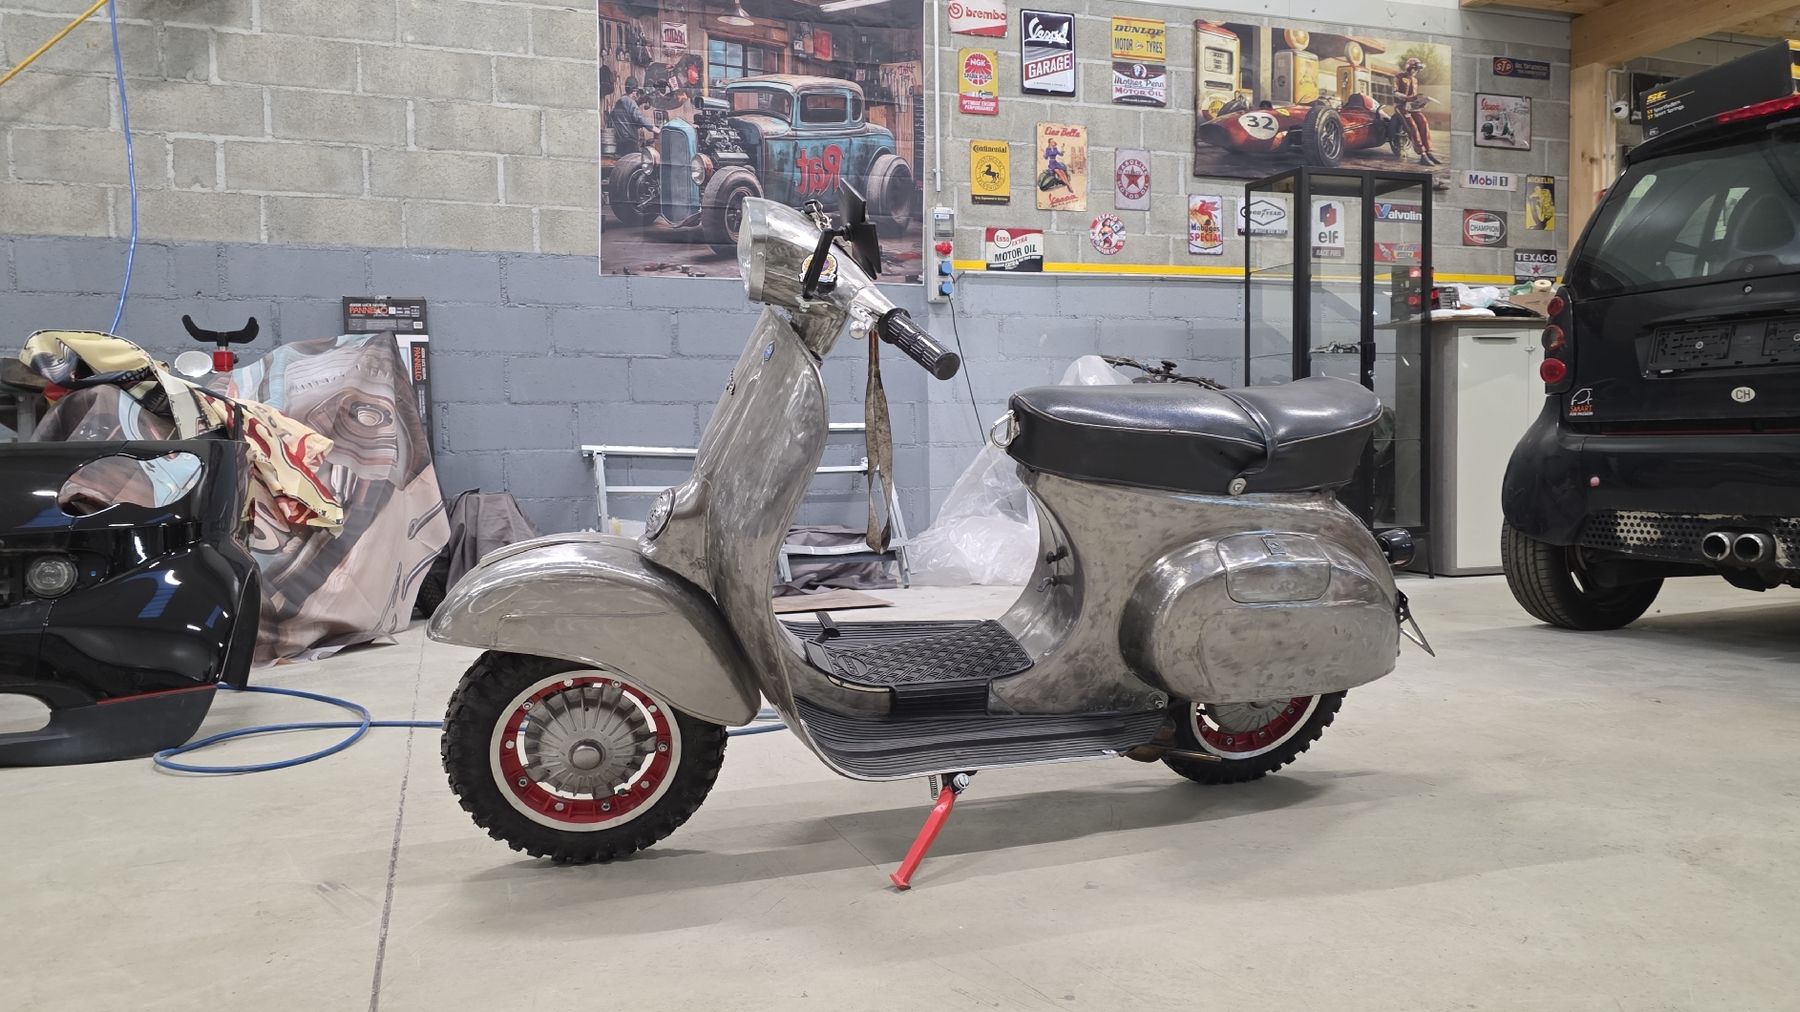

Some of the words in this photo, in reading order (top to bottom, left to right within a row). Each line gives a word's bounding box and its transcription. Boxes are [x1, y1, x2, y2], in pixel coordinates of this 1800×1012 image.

[966, 7, 1007, 20] brembo
[1025, 17, 1070, 44] Vespa
[1114, 25, 1164, 36] DUNLOP
[1114, 37, 1133, 51] MOTOR
[1146, 40, 1163, 54] TYRES
[970, 58, 986, 67] NGK
[1028, 55, 1072, 78] GARAGE
[1496, 61, 1512, 71] STP
[1114, 74, 1142, 86] Mother
[1144, 80, 1164, 88] Penn
[1246, 115, 1275, 131] 32
[1045, 126, 1060, 135] Ciao
[1060, 128, 1081, 137] Bella
[973, 145, 1007, 153] Continental
[1117, 159, 1148, 174] GASOLINE
[1469, 174, 1497, 186] Mobil
[1527, 176, 1554, 184] MICHELIN
[1048, 193, 1079, 206] Vespa
[1375, 203, 1422, 220] Valvolin
[1470, 224, 1499, 232] CHAMPION
[1012, 236, 1028, 246] EXTRA
[1190, 233, 1223, 242] SPECIAL
[1318, 230, 1339, 243] elf
[995, 248, 1022, 262] MOTOR
[1024, 244, 1037, 254] OIL
[1316, 248, 1329, 256] RACE
[1330, 249, 1342, 257] FUEL
[1516, 253, 1556, 262] TEXACO
[413, 346, 422, 381] PANNELLO
[1735, 389, 1751, 400] CH
